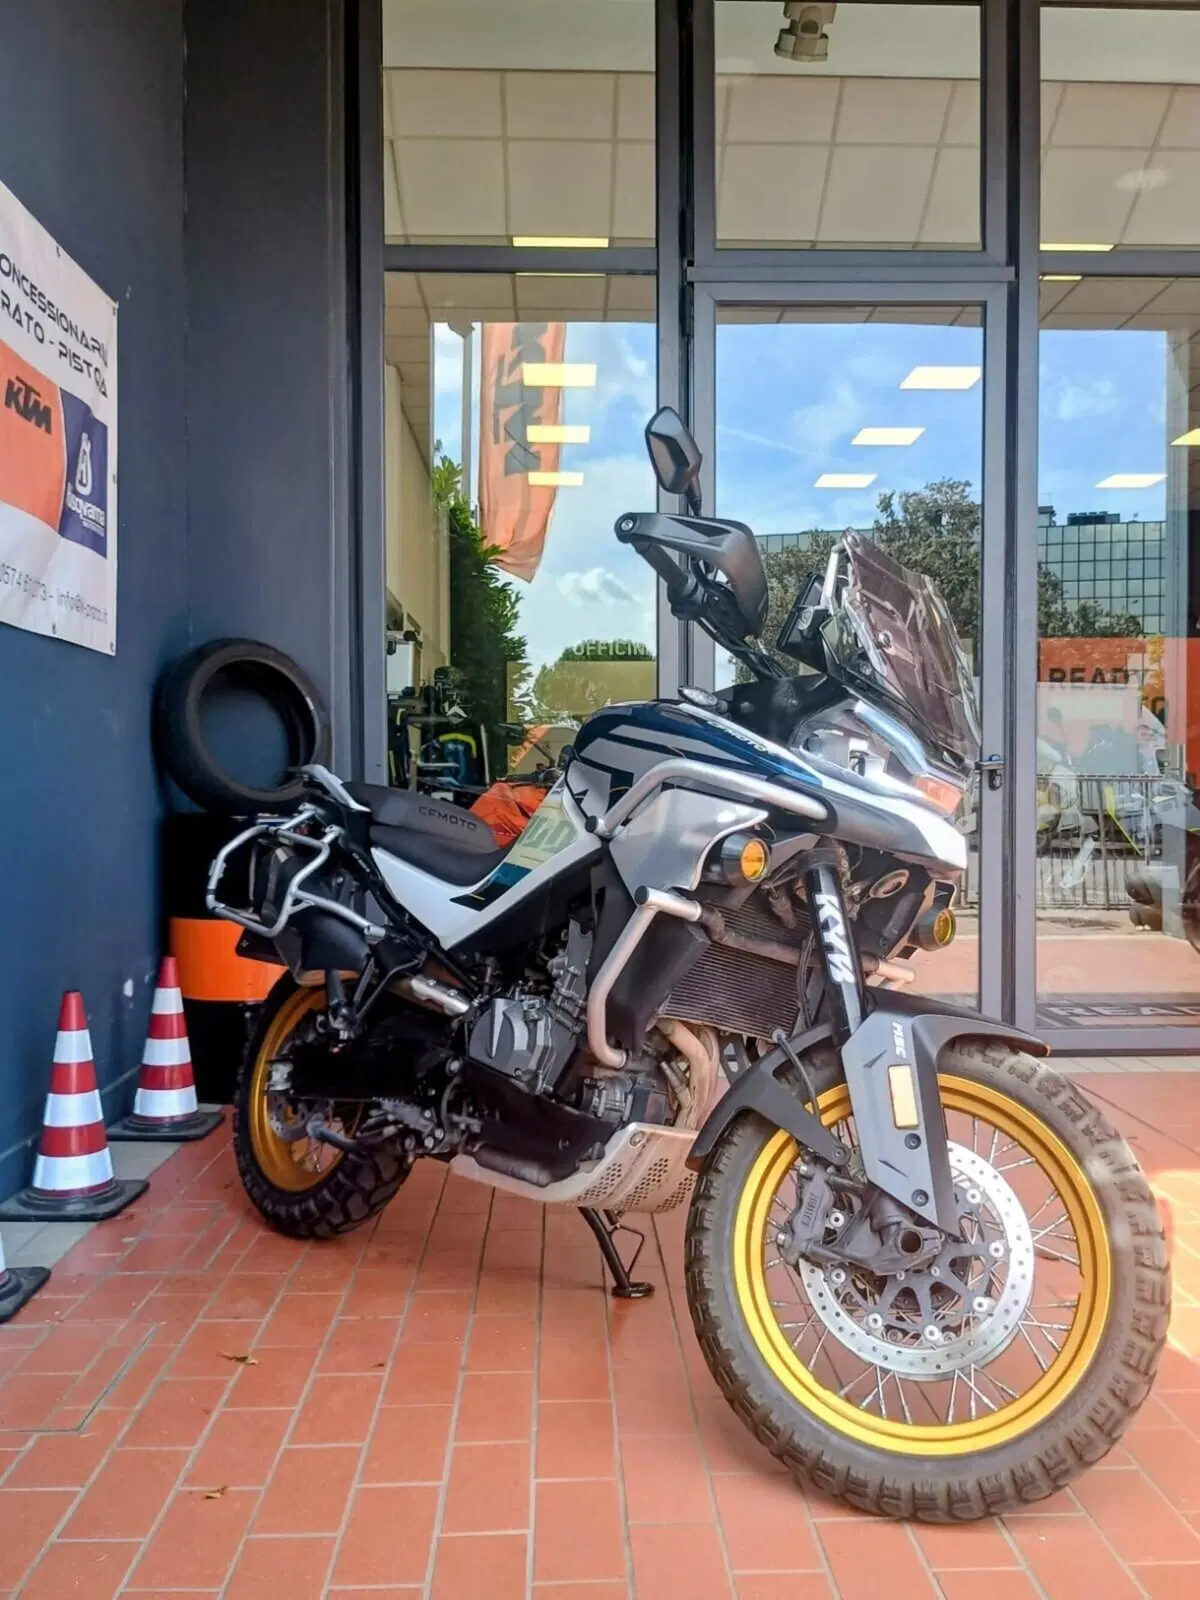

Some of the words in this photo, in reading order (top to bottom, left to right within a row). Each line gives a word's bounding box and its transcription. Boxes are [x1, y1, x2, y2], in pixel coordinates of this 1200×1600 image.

[4, 375, 53, 436] KTM
[572, 640, 650, 656] OFFICIN
[418, 806, 477, 833] CFMOTO
[814, 893, 856, 985] KYB
[892, 1020, 907, 1060] MSC
